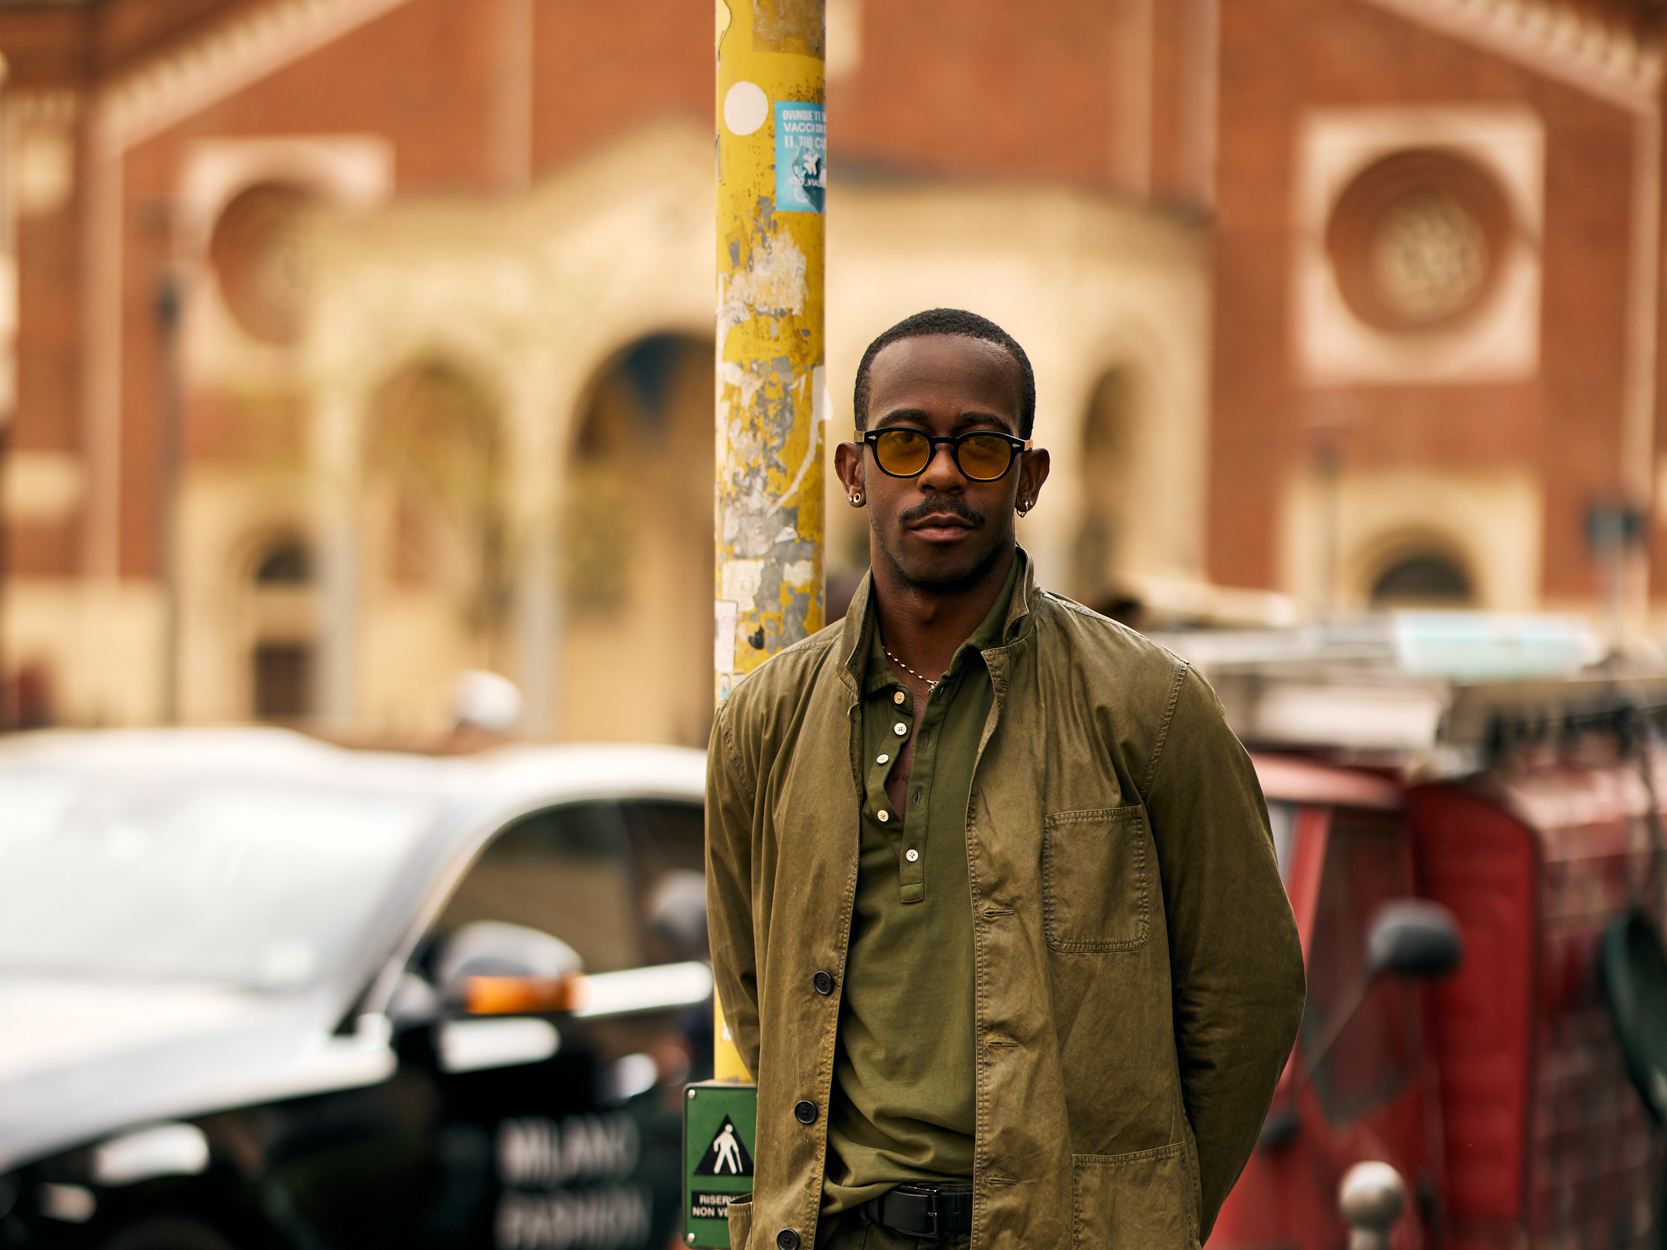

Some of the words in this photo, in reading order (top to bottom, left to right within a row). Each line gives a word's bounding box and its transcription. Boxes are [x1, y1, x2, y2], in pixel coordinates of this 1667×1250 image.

[782, 110, 814, 121] OVUNQUE
[783, 122, 815, 132] VACCI
[699, 1194, 741, 1205] RISERV
[692, 1206, 715, 1217] NON
[717, 1207, 729, 1217] VE
